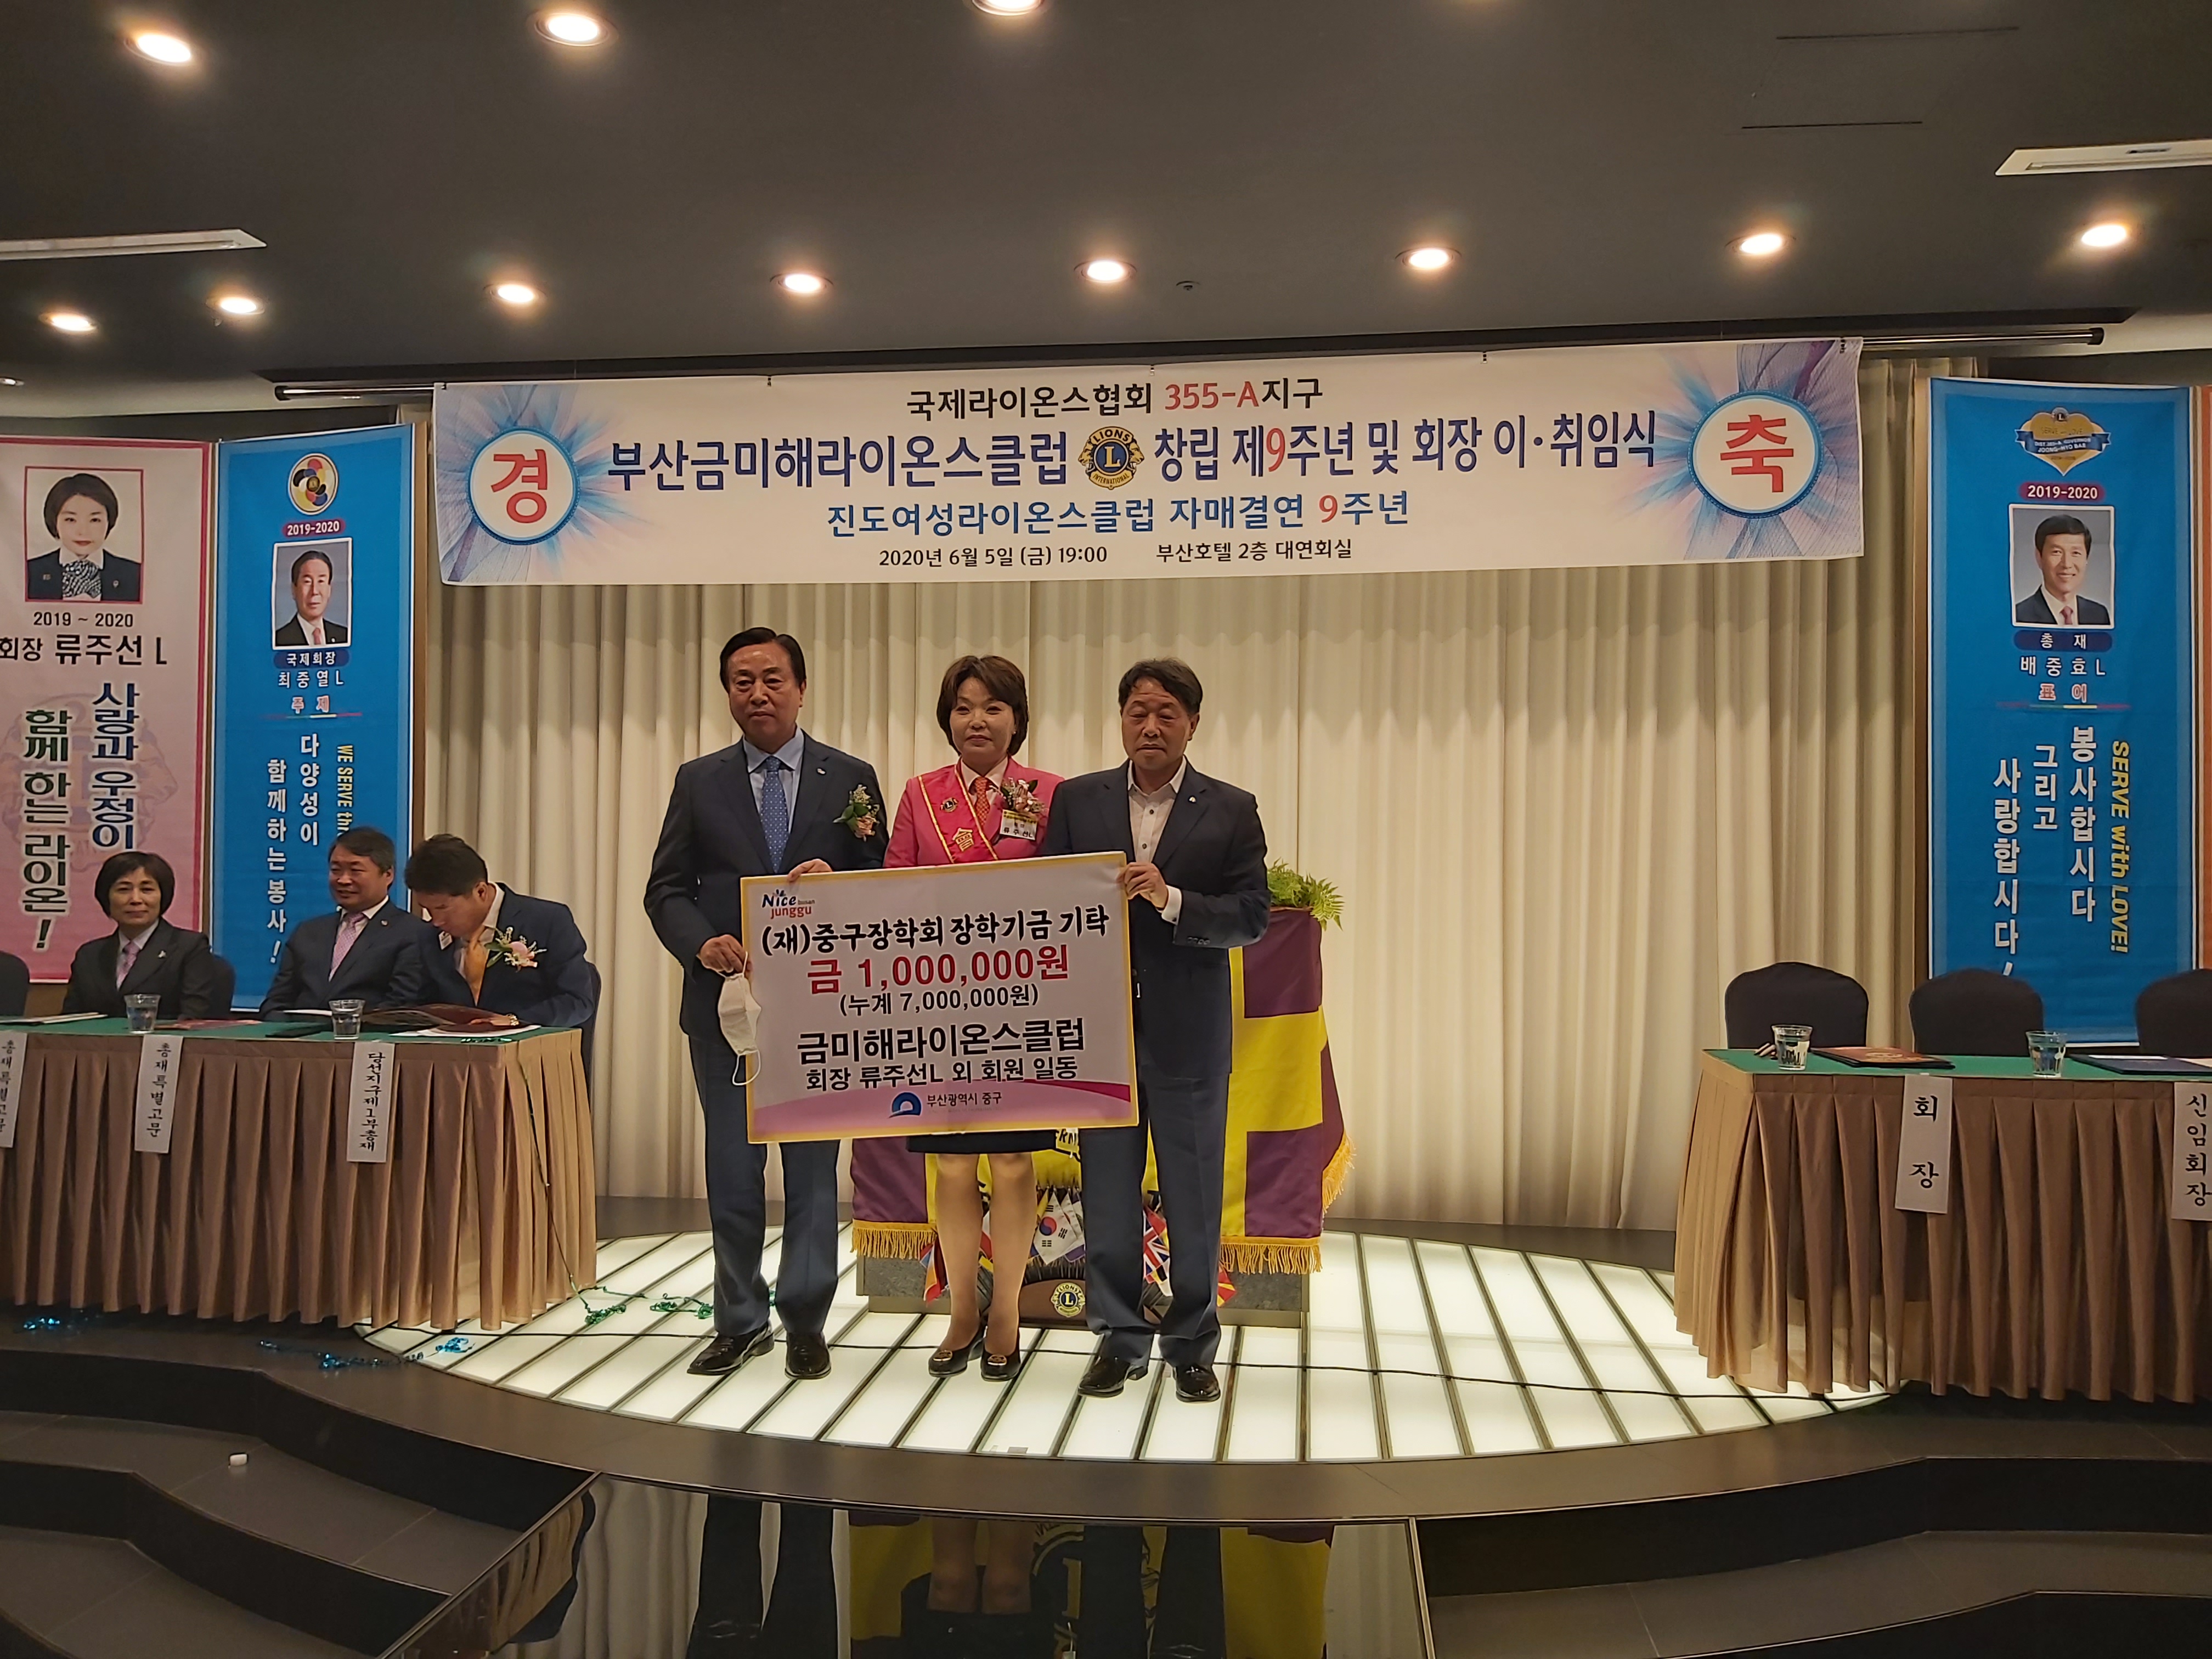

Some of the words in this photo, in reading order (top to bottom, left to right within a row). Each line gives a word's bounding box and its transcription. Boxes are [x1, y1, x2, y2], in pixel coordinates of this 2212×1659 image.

[907, 383, 1151, 421] 국제라이온스협회
[1165, 377, 1323, 410] 355-A지구
[1092, 429, 1130, 443] LIONS
[1154, 427, 1218, 482] 창립
[1232, 421, 1354, 478] 제9주년
[1368, 420, 1398, 475] 및
[1412, 417, 1482, 472] 회장
[1719, 413, 1795, 494] 축
[607, 431, 1066, 491] 부산금미해라이온스클럽
[1092, 473, 1130, 484] INTERNATIONAL
[490, 448, 548, 524] 경
[2028, 485, 2098, 500] 2019-2020
[287, 521, 340, 536] 2019-2020
[827, 496, 1153, 538] 진도여성라이온스클럽
[1169, 494, 1304, 530] 자매결연
[1318, 490, 1408, 526] 9주년
[879, 549, 943, 567] 2020년
[949, 548, 978, 567] 6월
[985, 547, 1013, 567] 5일
[1020, 546, 1052, 566] (금)
[1058, 546, 1108, 564] 19:00
[1156, 541, 1232, 563] 부산호텔
[1238, 541, 1268, 561] 2층
[1276, 538, 1352, 560] 대연회실
[33, 611, 71, 627] 2019
[94, 613, 134, 628] 2020
[0, 637, 43, 662] 회장
[55, 634, 143, 665] 류주선
[286, 652, 336, 666] 국제회장
[23, 709, 72, 762] 함께
[92, 682, 140, 761] 사랑과
[337, 745, 353, 763] WE
[24, 772, 71, 824] 하는
[300, 733, 320, 847] 다양성이
[337, 766, 353, 808] SERVE
[2033, 745, 2058, 830] 그리고
[2111, 741, 2130, 819] SERVE
[92, 771, 136, 850] 우정이
[2070, 726, 2097, 922] 봉사합시다
[2111, 825, 2130, 878] with
[22, 834, 71, 949] 라이온!
[762, 894, 797, 908] Nice
[770, 906, 812, 919] junggu
[762, 915, 944, 956] (재)중구장학회
[950, 909, 1053, 945] 장학기금
[1058, 904, 1110, 938] 기탁
[2111, 884, 2130, 954] LOVE!
[808, 959, 842, 995] 금
[858, 944, 1068, 991] 1,000,000원
[839, 992, 892, 1017] (누계
[900, 983, 1039, 1013] 7,000,000원)
[797, 1017, 1084, 1065] 금미해라이온스클럽
[806, 1067, 851, 1092] 회장
[859, 1063, 944, 1089] 류주선L
[952, 1060, 972, 1084] 외
[981, 1057, 1024, 1082] 회원
[1033, 1056, 1078, 1080] 일동
[927, 1092, 978, 1107] 부산광역시
[982, 1091, 1002, 1105] 중구
[2185, 1093, 2212, 1207] 신임회장
